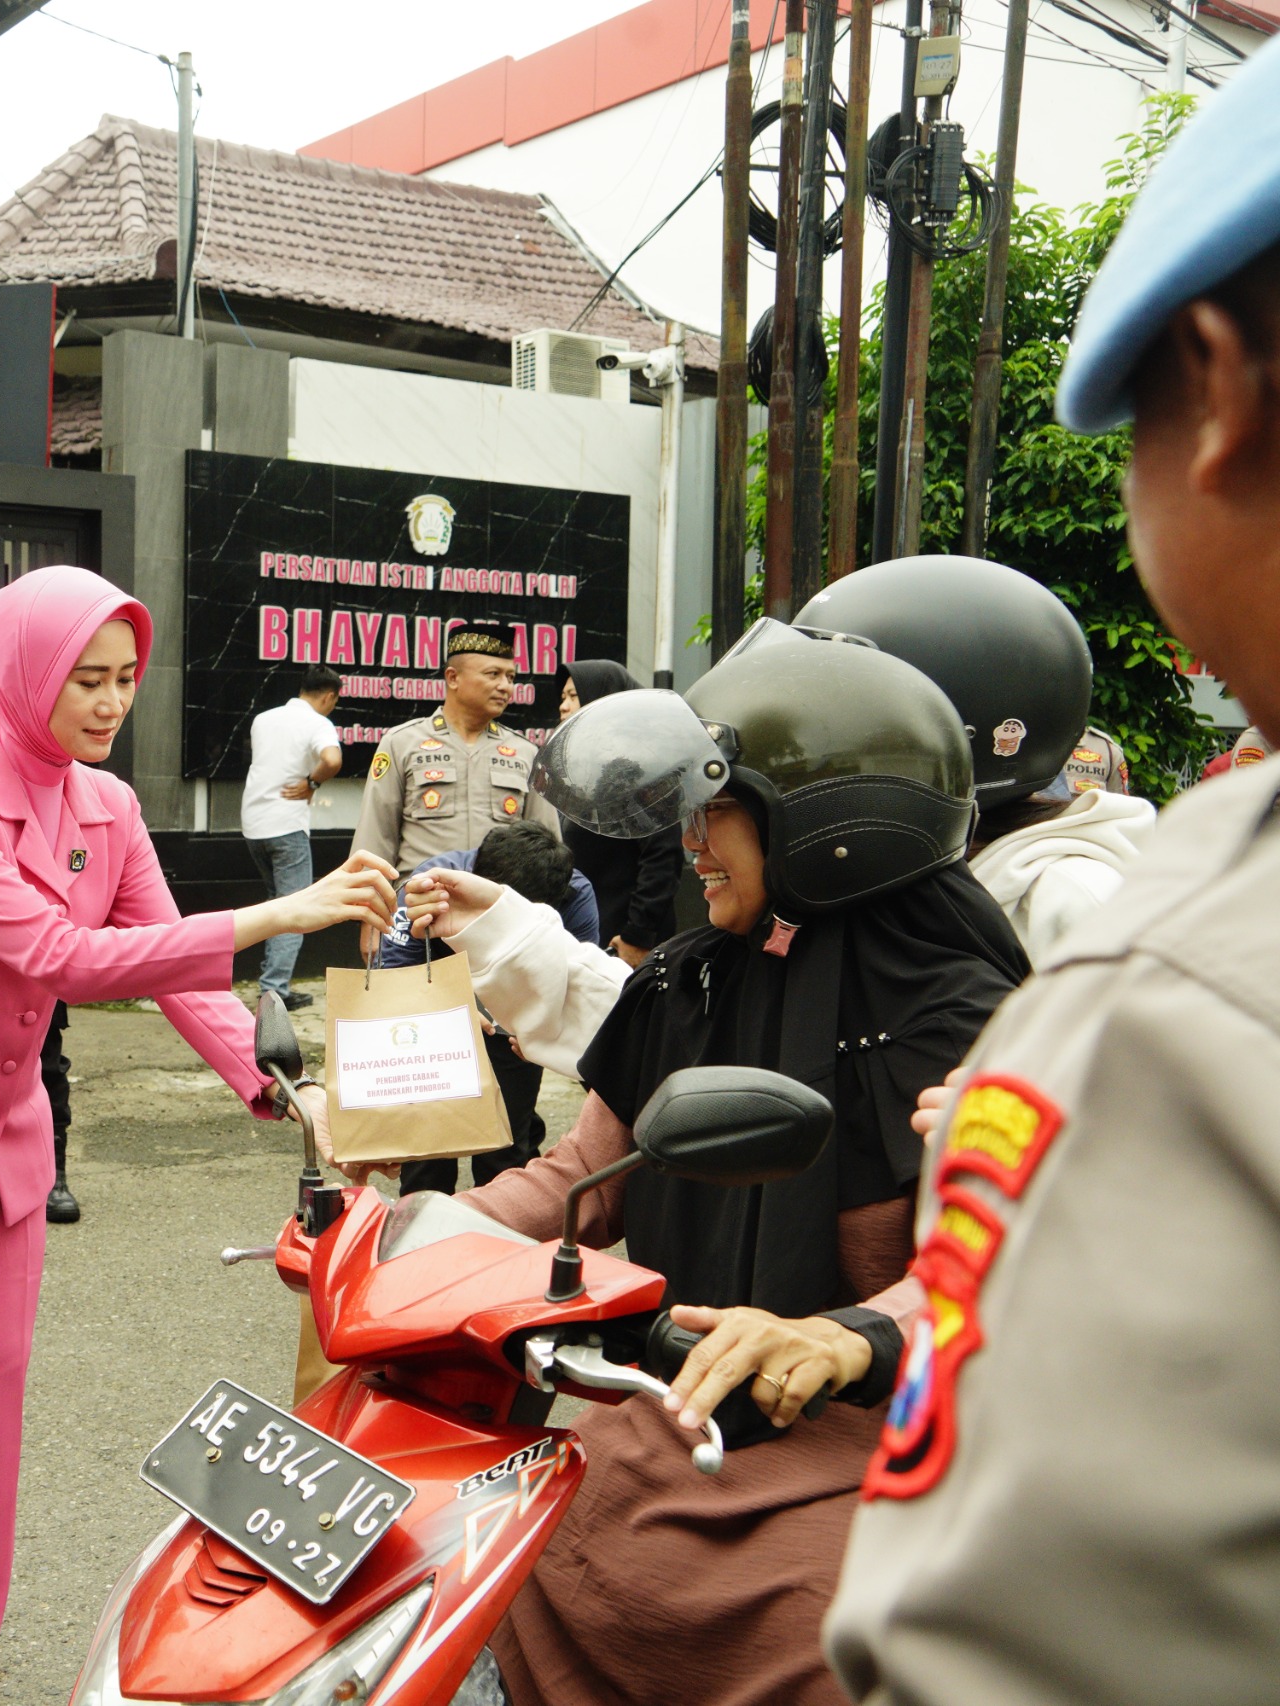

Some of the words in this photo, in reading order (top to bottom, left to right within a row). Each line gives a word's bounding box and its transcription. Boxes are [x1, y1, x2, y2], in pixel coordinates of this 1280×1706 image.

[260, 551, 377, 587] PERSATUAN
[380, 562, 434, 591] ISTRI
[440, 566, 524, 596] ANGGOTA
[525, 573, 577, 599] POLRI
[259, 604, 577, 676] BHAYANARI
[339, 675, 391, 699] GURUS
[393, 677, 446, 700] CABAN
[417, 754, 451, 764] SENO
[492, 757, 524, 771] POLRI
[1066, 763, 1106, 777] POLRI
[343, 1055, 425, 1071] BHAYANGKARI
[430, 1050, 472, 1063] PEDULI
[376, 1074, 410, 1085] PENGURUS
[412, 1071, 440, 1082] CABANG
[367, 1086, 413, 1098] BHAYANGKARI
[415, 1082, 451, 1093] PONOROGO
[190, 1393, 248, 1446] AE
[244, 1421, 338, 1500] 5344
